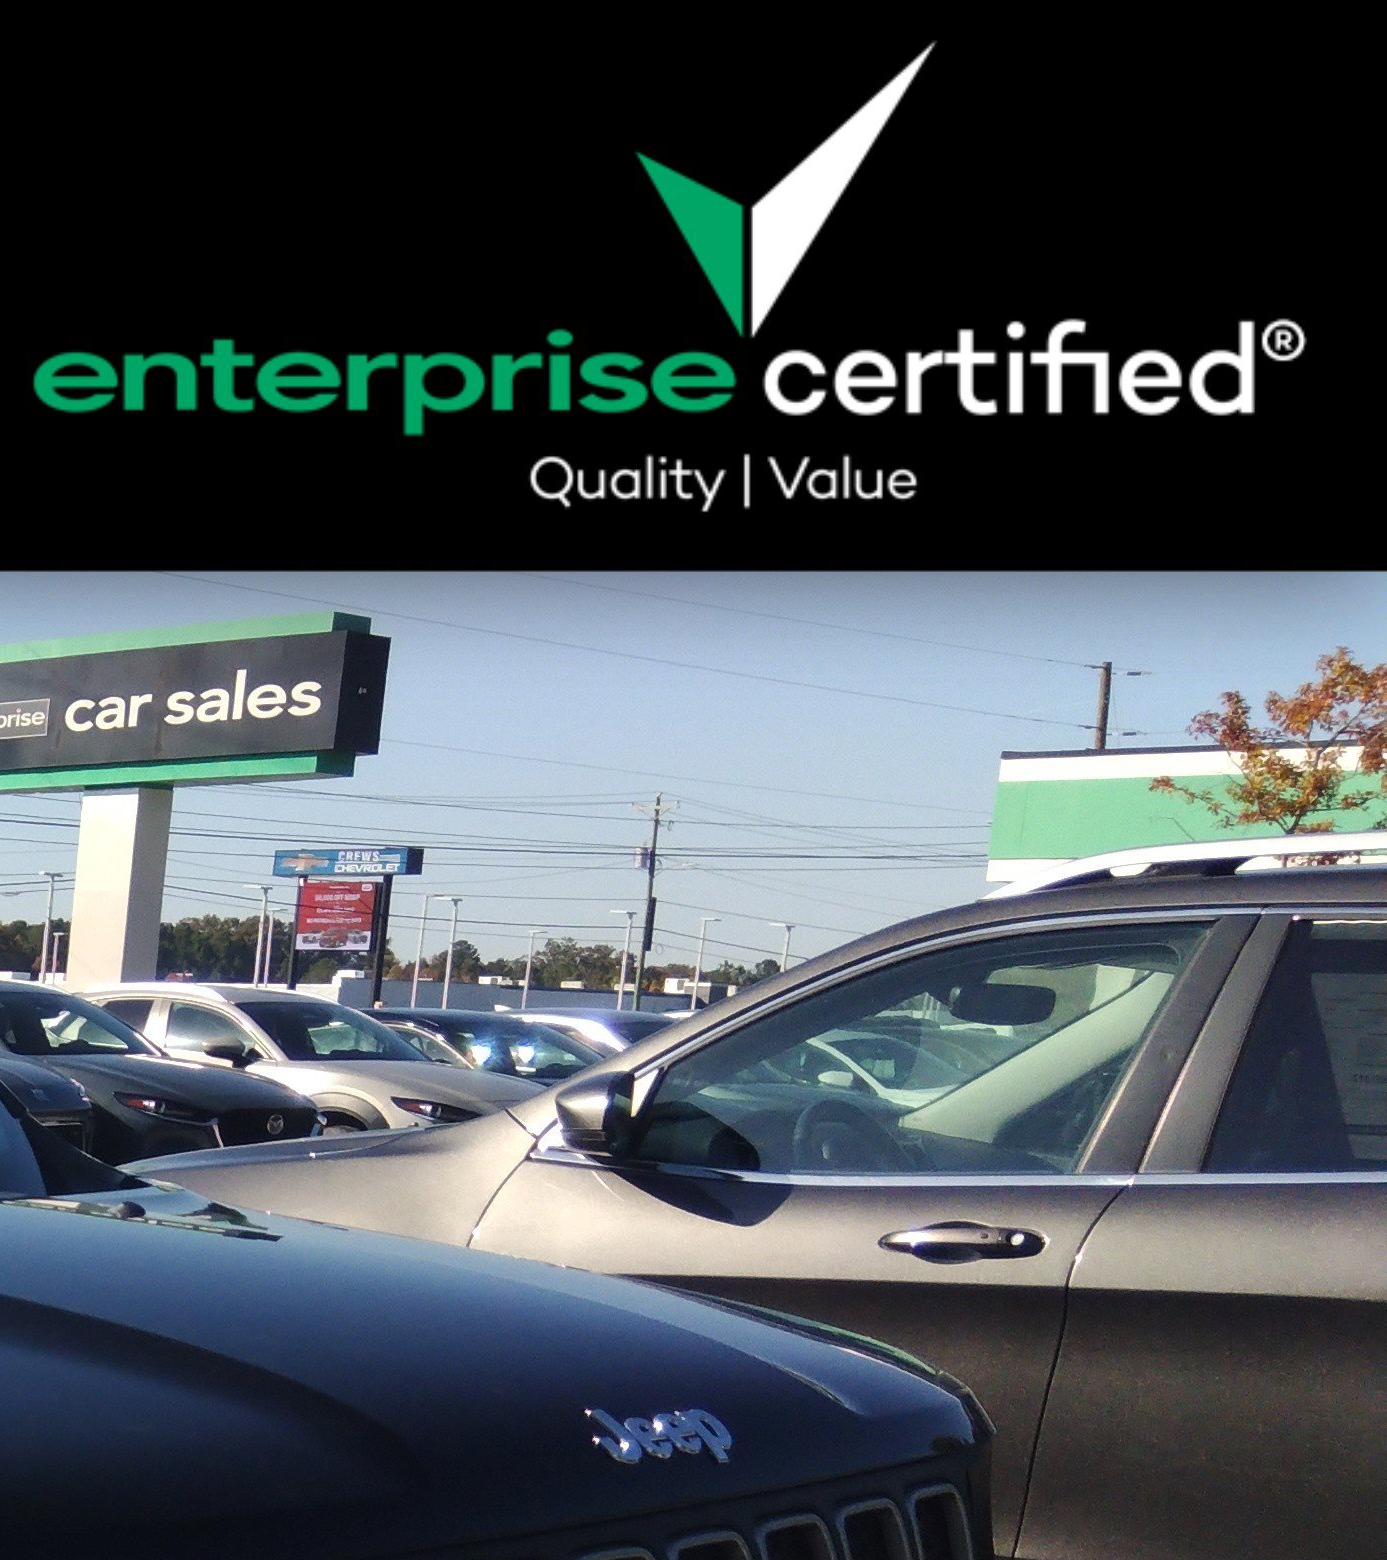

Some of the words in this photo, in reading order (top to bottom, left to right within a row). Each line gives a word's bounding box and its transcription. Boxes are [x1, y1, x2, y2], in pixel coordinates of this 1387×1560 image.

[64, 691, 152, 732] car
[164, 669, 323, 726] sales
[334, 863, 400, 873] CHEVROLET
[338, 850, 380, 862] CREWS
[584, 1408, 733, 1465] Jeep
